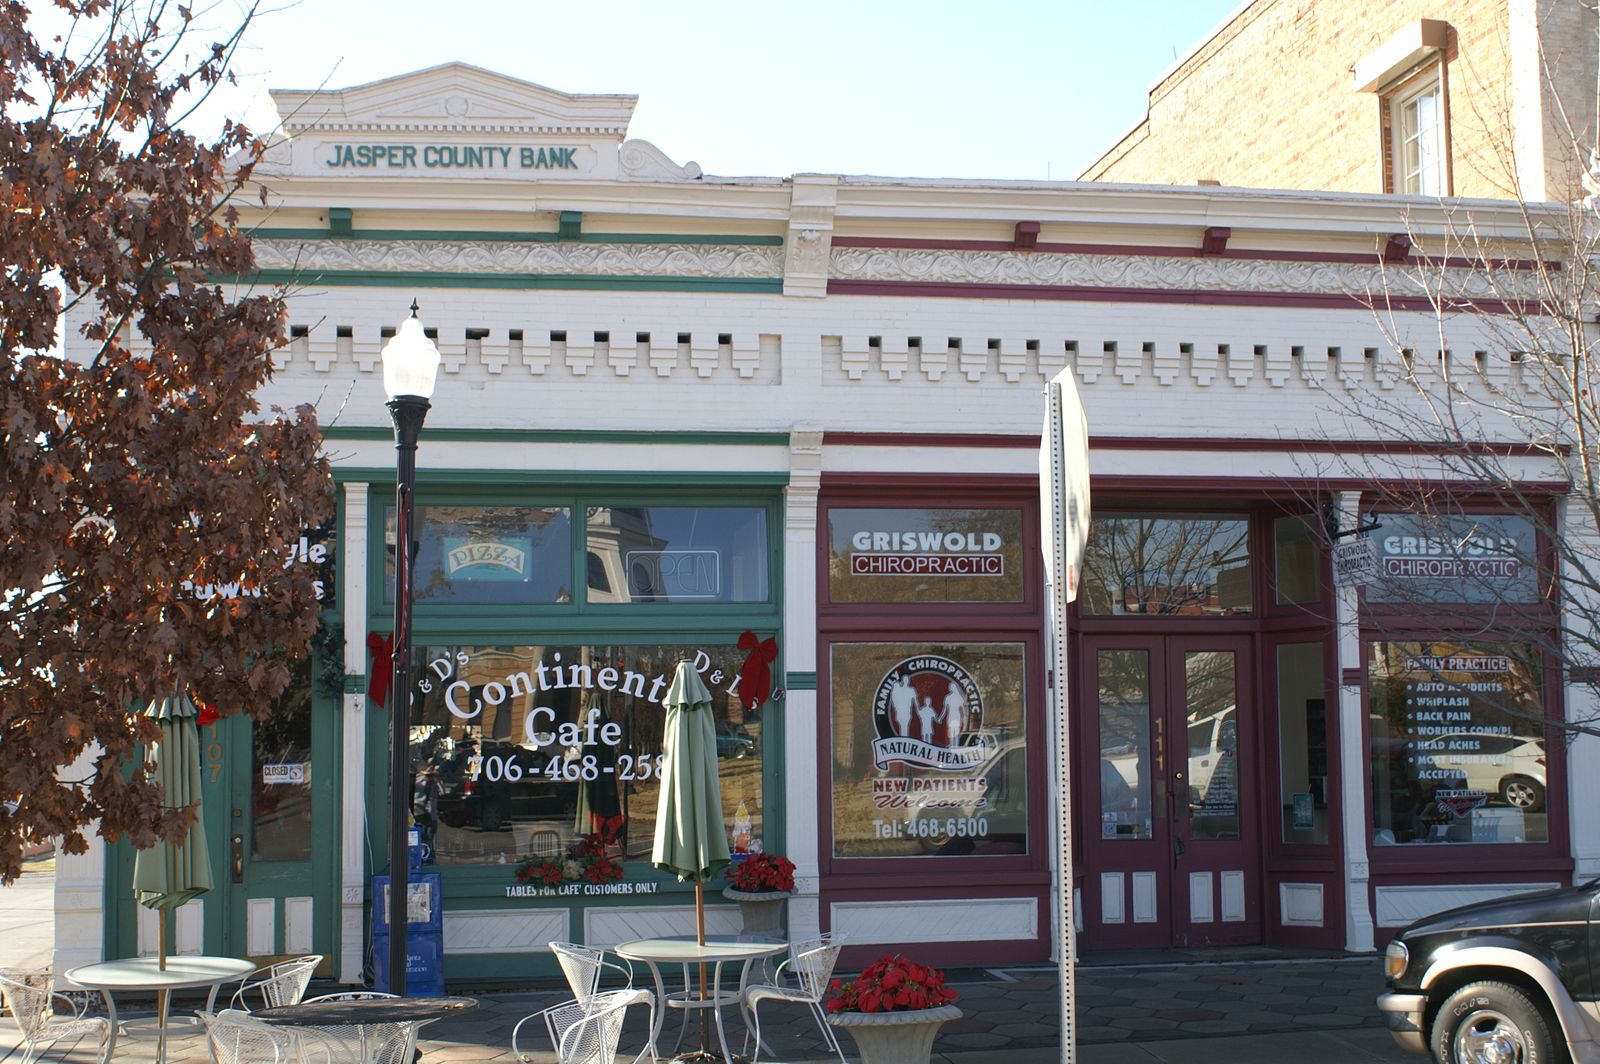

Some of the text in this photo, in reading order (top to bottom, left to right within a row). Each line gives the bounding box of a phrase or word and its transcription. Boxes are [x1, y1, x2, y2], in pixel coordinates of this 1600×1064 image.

[326, 144, 578, 170] JASPER COUNTY BANK
[852, 531, 1002, 552] GRISWOLD
[452, 544, 523, 571] PIZZA
[855, 556, 999, 573] CHIROPRACTIC
[630, 554, 716, 593] OPEN
[1387, 559, 1516, 577] CHIROPRACTIC
[1449, 658, 1507, 670] PRACTICE
[418, 651, 470, 694] & D's
[710, 669, 724, 685] &
[444, 651, 671, 719] Continent
[876, 659, 981, 716] FAMILY CHIROPRACTIC
[1416, 682, 1445, 692] AUTO
[1416, 697, 1470, 707] WHIPLASH
[1416, 711, 1471, 721] BACK PAIN
[525, 706, 622, 747] Cafe
[1416, 725, 1467, 736] WORKERS
[880, 741, 981, 765] NATURAL HEALTH
[1416, 740, 1480, 750] HEAD ACHES
[1417, 755, 1445, 765] MOST
[264, 766, 289, 776] CLOSED
[1418, 770, 1468, 779] ACCEPTED
[873, 778, 987, 793] NEW PATIENTS
[874, 794, 987, 809] Welcome
[872, 817, 989, 839] Tel: 468-6500
[505, 885, 537, 897] TABLES
[584, 883, 633, 895] CUSTOMERS
[635, 882, 658, 894] ONLY
